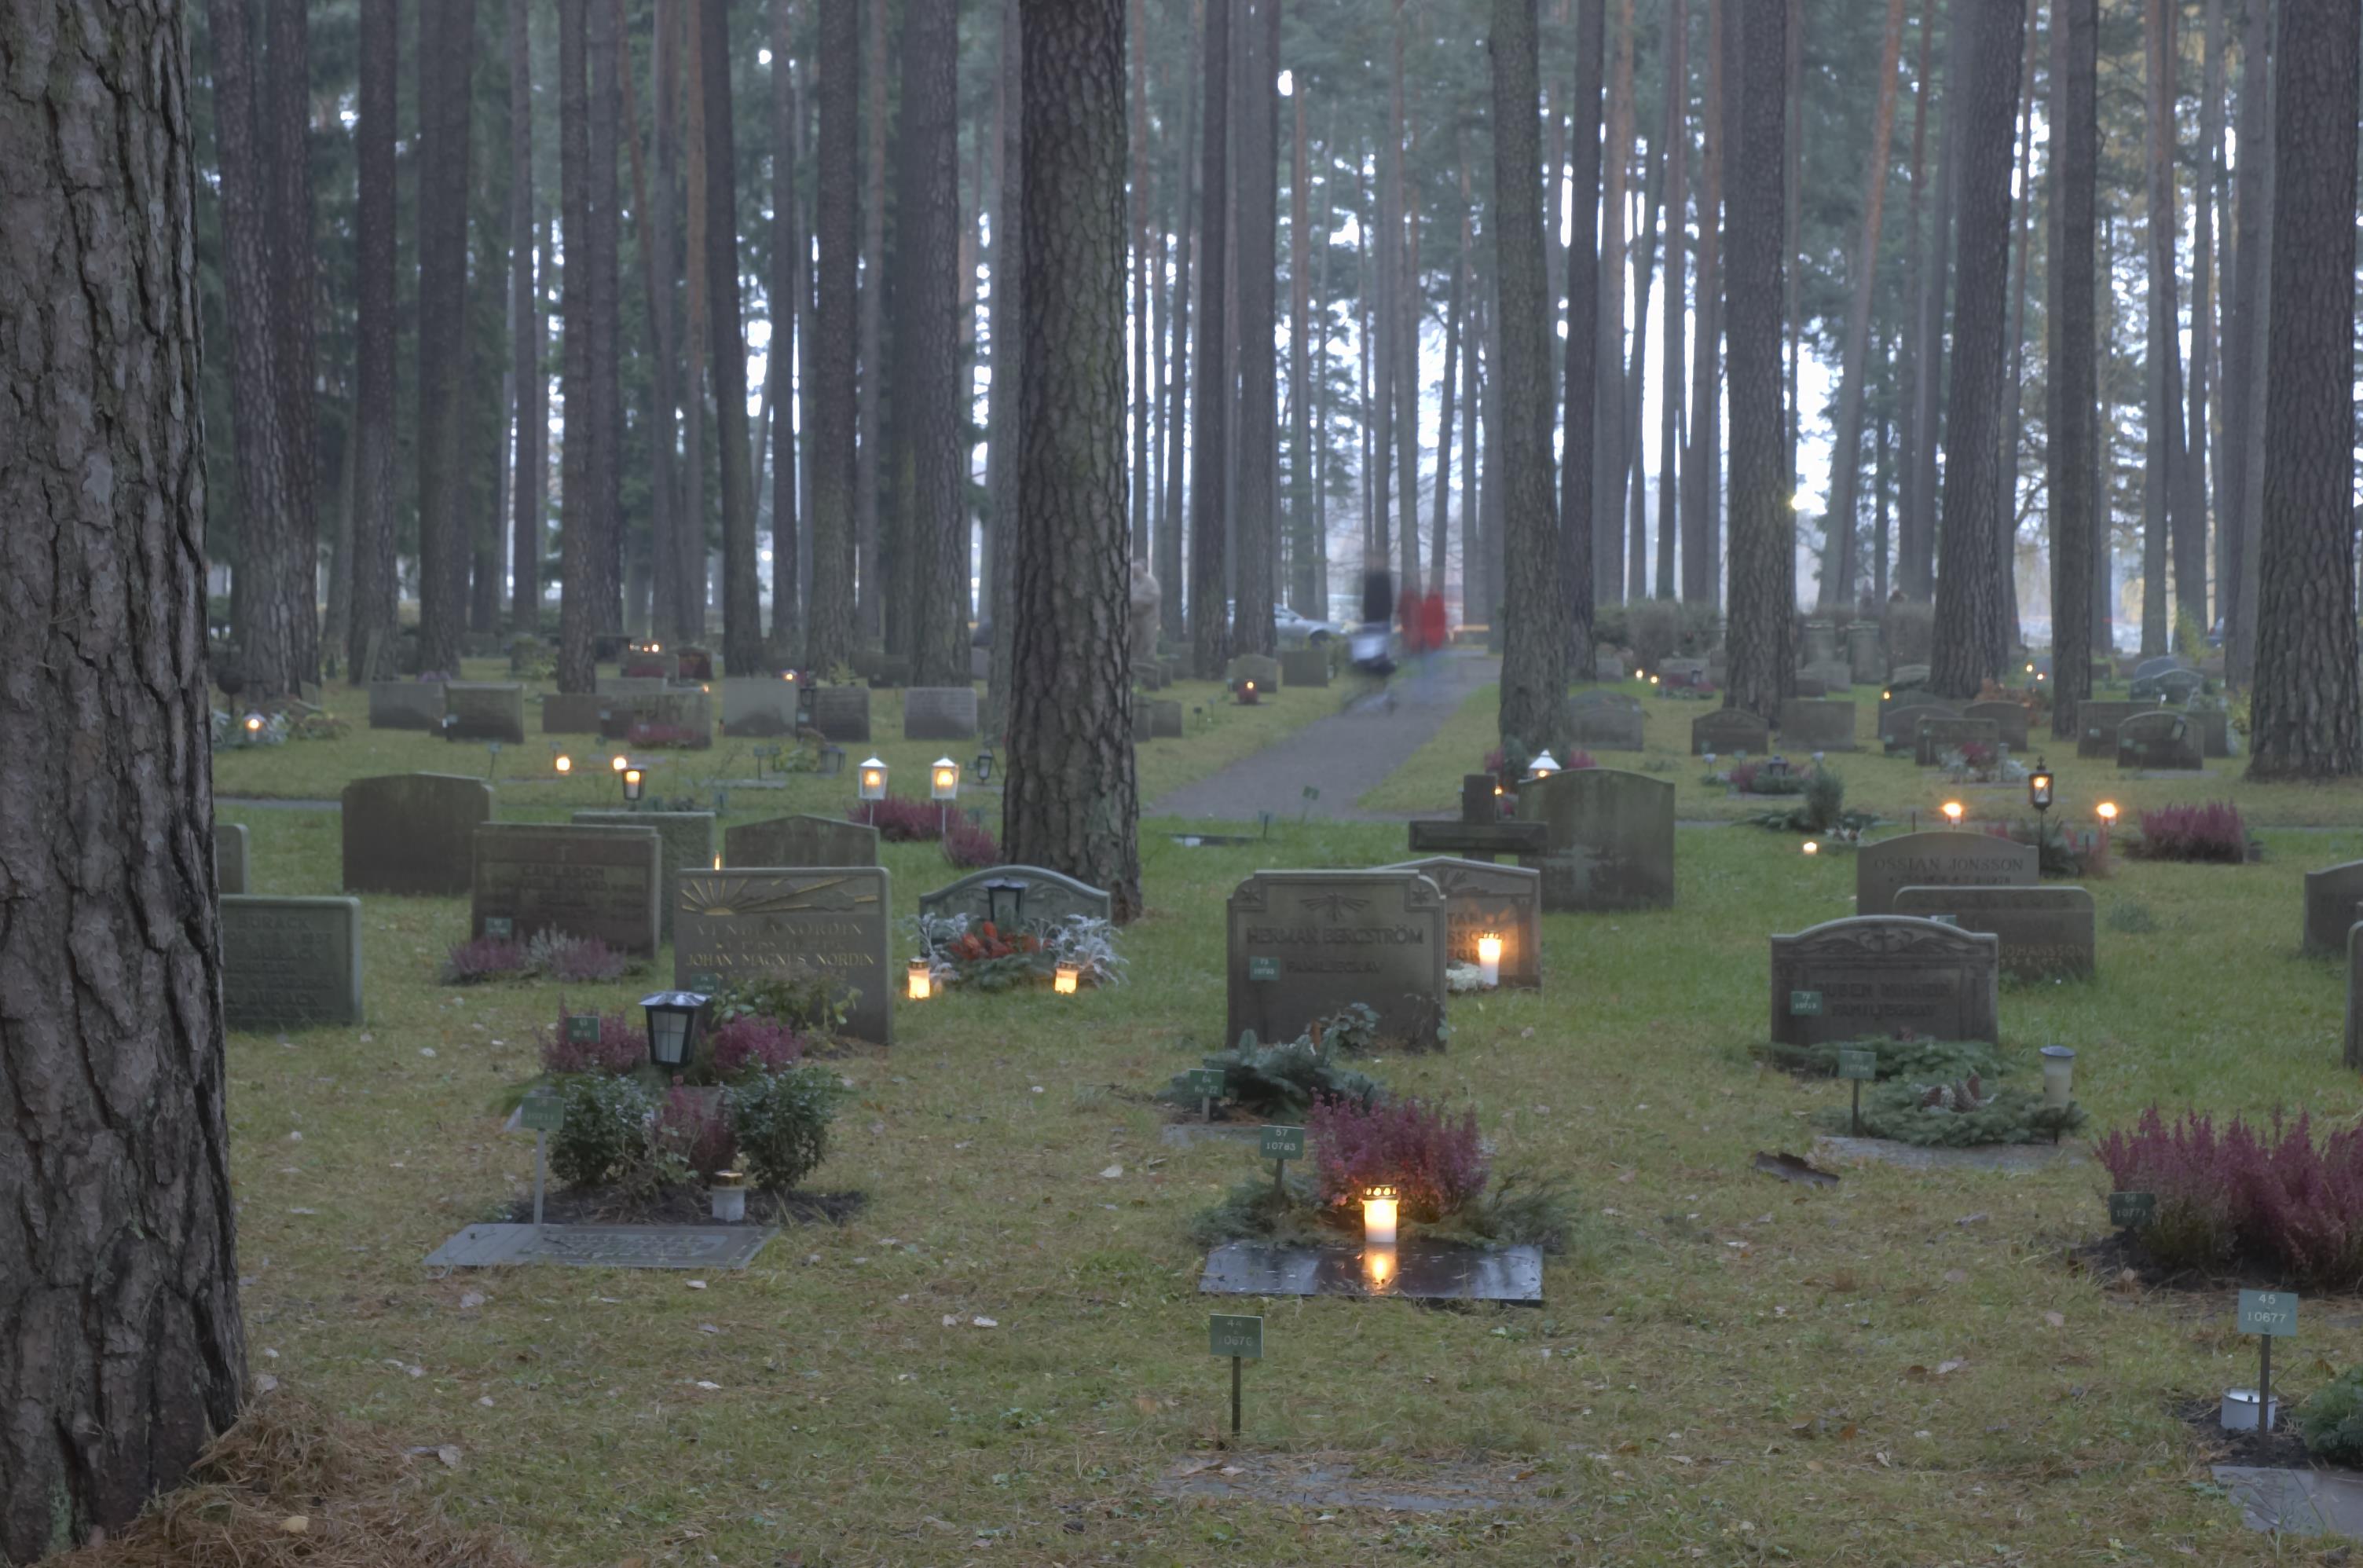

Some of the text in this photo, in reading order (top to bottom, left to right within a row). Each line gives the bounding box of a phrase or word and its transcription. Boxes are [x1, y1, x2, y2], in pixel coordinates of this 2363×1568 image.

[1874, 857, 2024, 871] OSSIAN JONSSON
[1247, 923, 1423, 944] HERMAN BERGSTRÖM
[687, 953, 733, 966] JOHAN
[2258, 1293, 2276, 1305] 45
[2247, 1312, 2287, 1324] 10677
